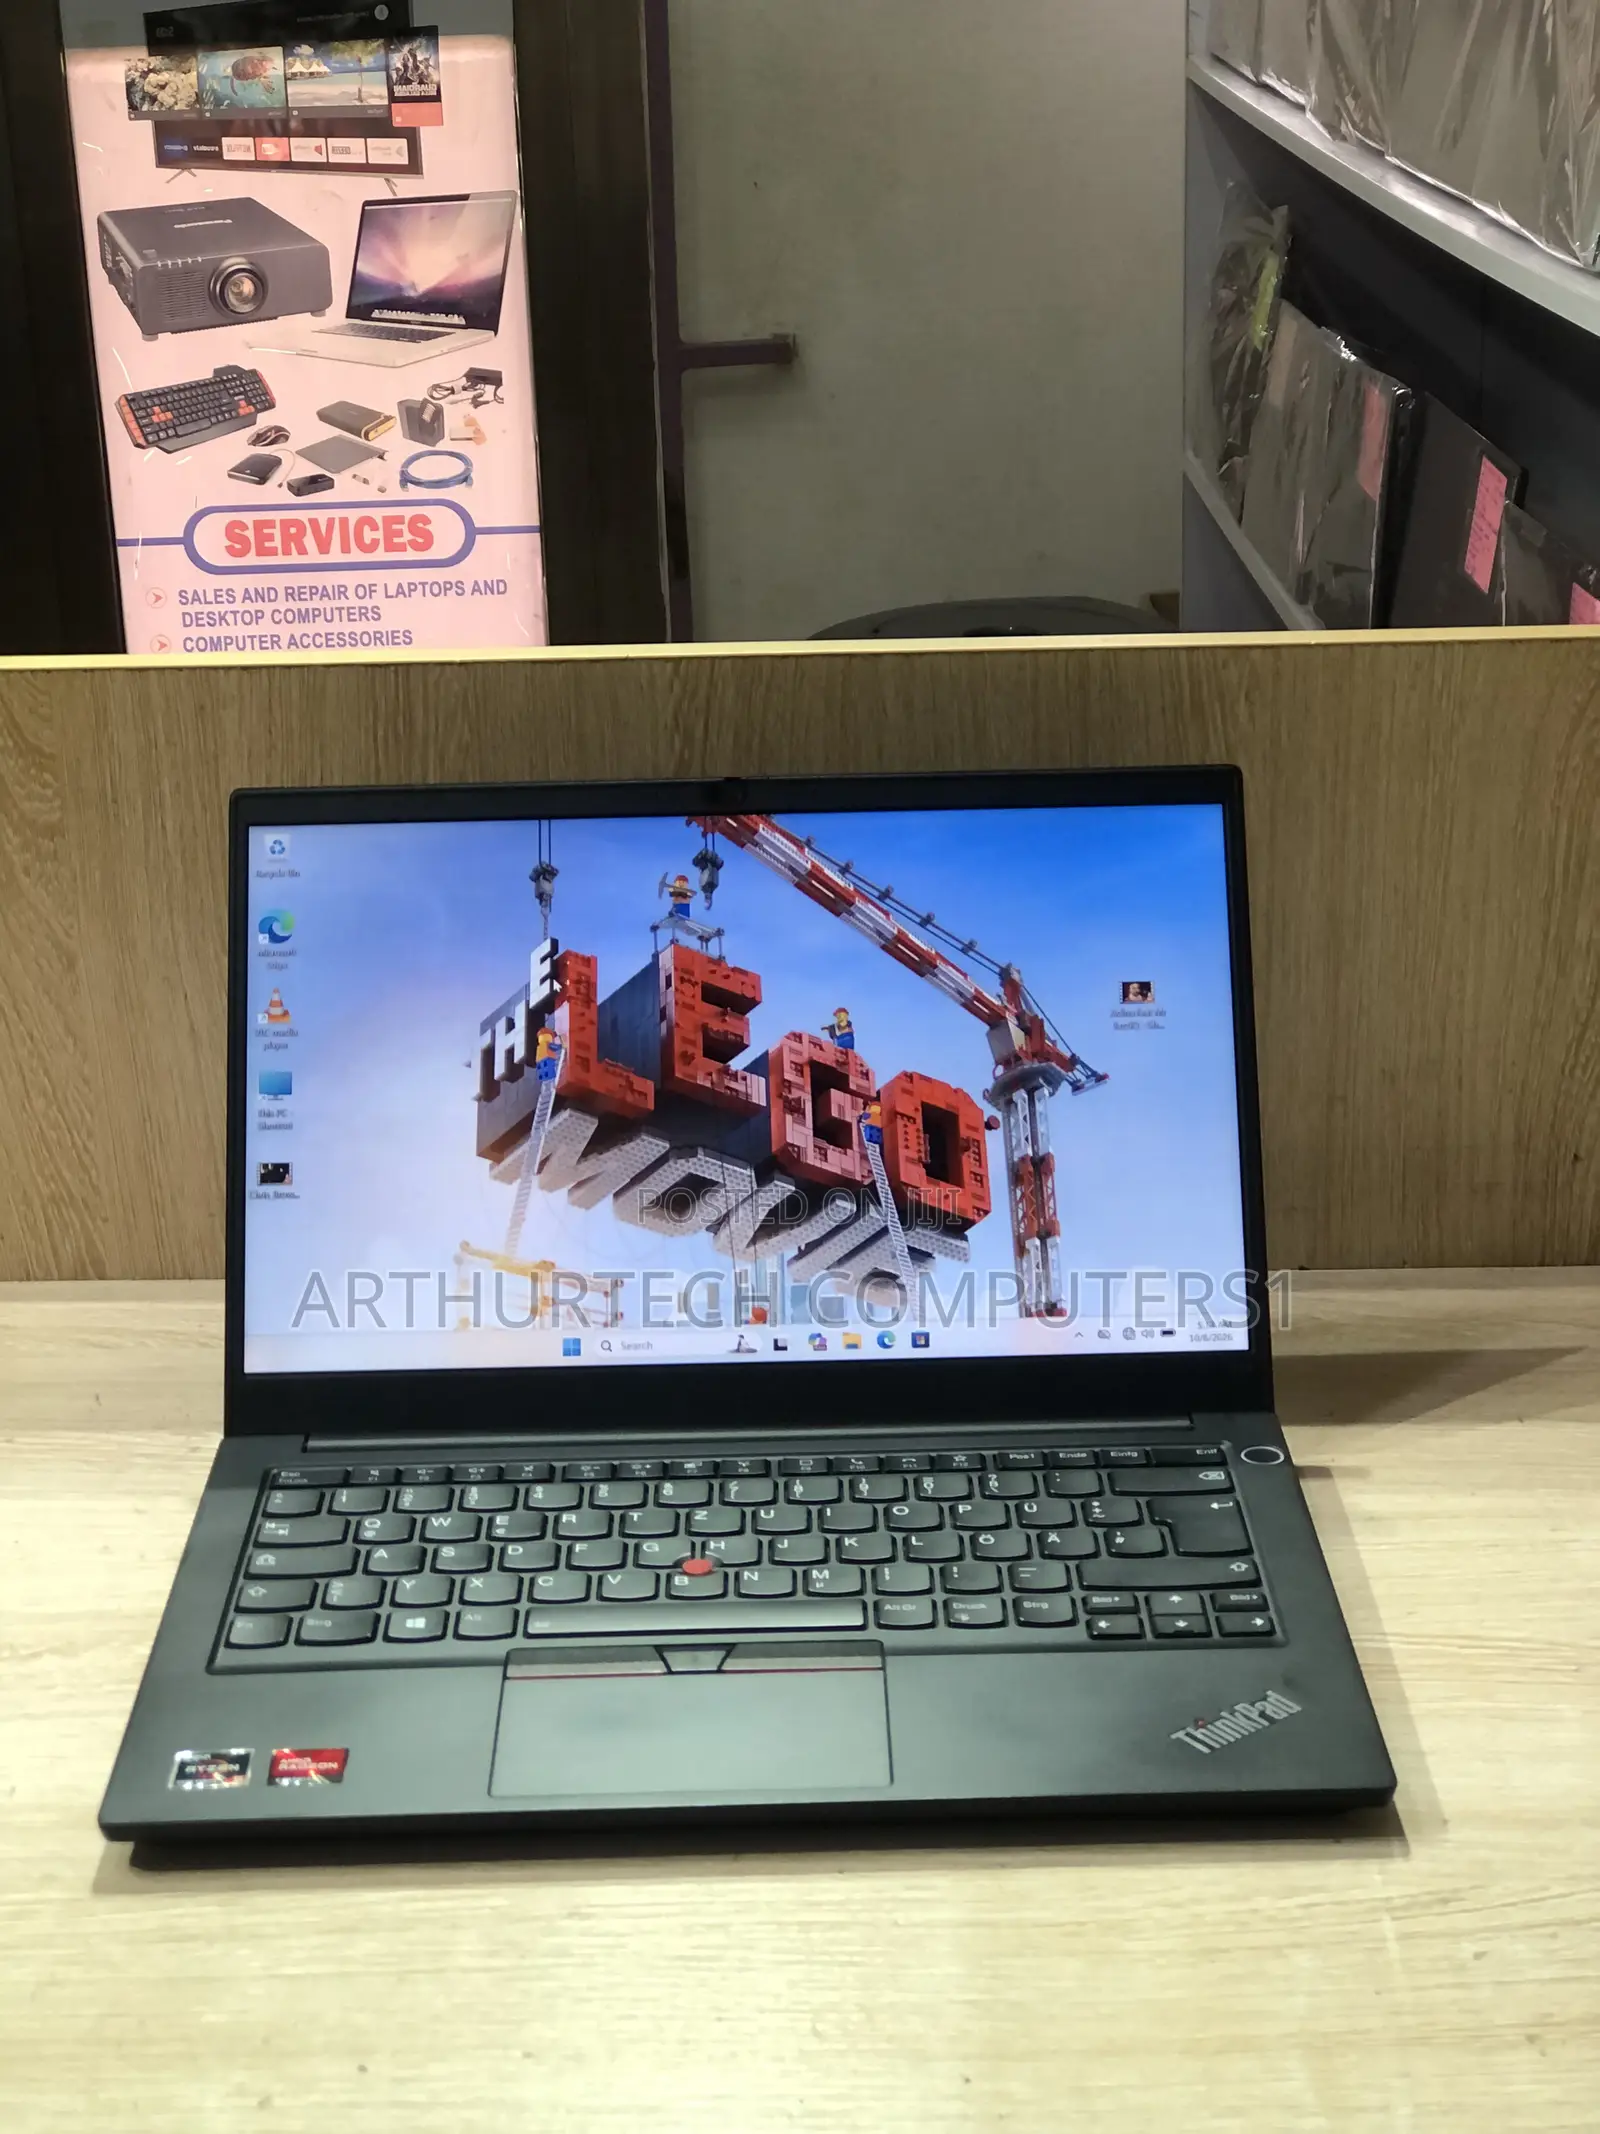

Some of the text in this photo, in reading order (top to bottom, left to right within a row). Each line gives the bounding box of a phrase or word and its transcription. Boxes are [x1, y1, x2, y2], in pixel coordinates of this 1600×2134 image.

[225, 514, 434, 558] SERVICES
[178, 579, 508, 605] SALES AND REPAIR OF LAPTOPS AND
[181, 605, 382, 628] DESKTOP COMPUTERS
[183, 629, 413, 652] COMPUTER ACCESSORIES
[553, 942, 992, 1232] LEGO
[620, 1341, 653, 1350] Search
[760, 1509, 775, 1519] U
[892, 1505, 909, 1515] O
[958, 1504, 972, 1514] P
[495, 1515, 509, 1525] E
[561, 1513, 576, 1523] R
[628, 1511, 643, 1522] T
[693, 1510, 708, 1520] Z
[364, 1518, 381, 1528] Q
[431, 1516, 452, 1527] W
[844, 1537, 859, 1547] K
[911, 1535, 923, 1545] L
[978, 1534, 995, 1545] Ö
[1047, 1531, 1060, 1543] Ä
[575, 1543, 588, 1553] F
[642, 1542, 660, 1552] G
[709, 1540, 725, 1550] H
[777, 1538, 788, 1548] J
[373, 1548, 388, 1559] A
[440, 1546, 455, 1557] S
[507, 1545, 523, 1555] D
[607, 1574, 622, 1584] V
[743, 1571, 759, 1581] N
[812, 1569, 829, 1579] M
[402, 1579, 416, 1590] Y
[470, 1577, 484, 1588] X
[537, 1575, 553, 1586] C
[674, 1575, 689, 1586] B
[1170, 1690, 1302, 1754] ThinkPad
